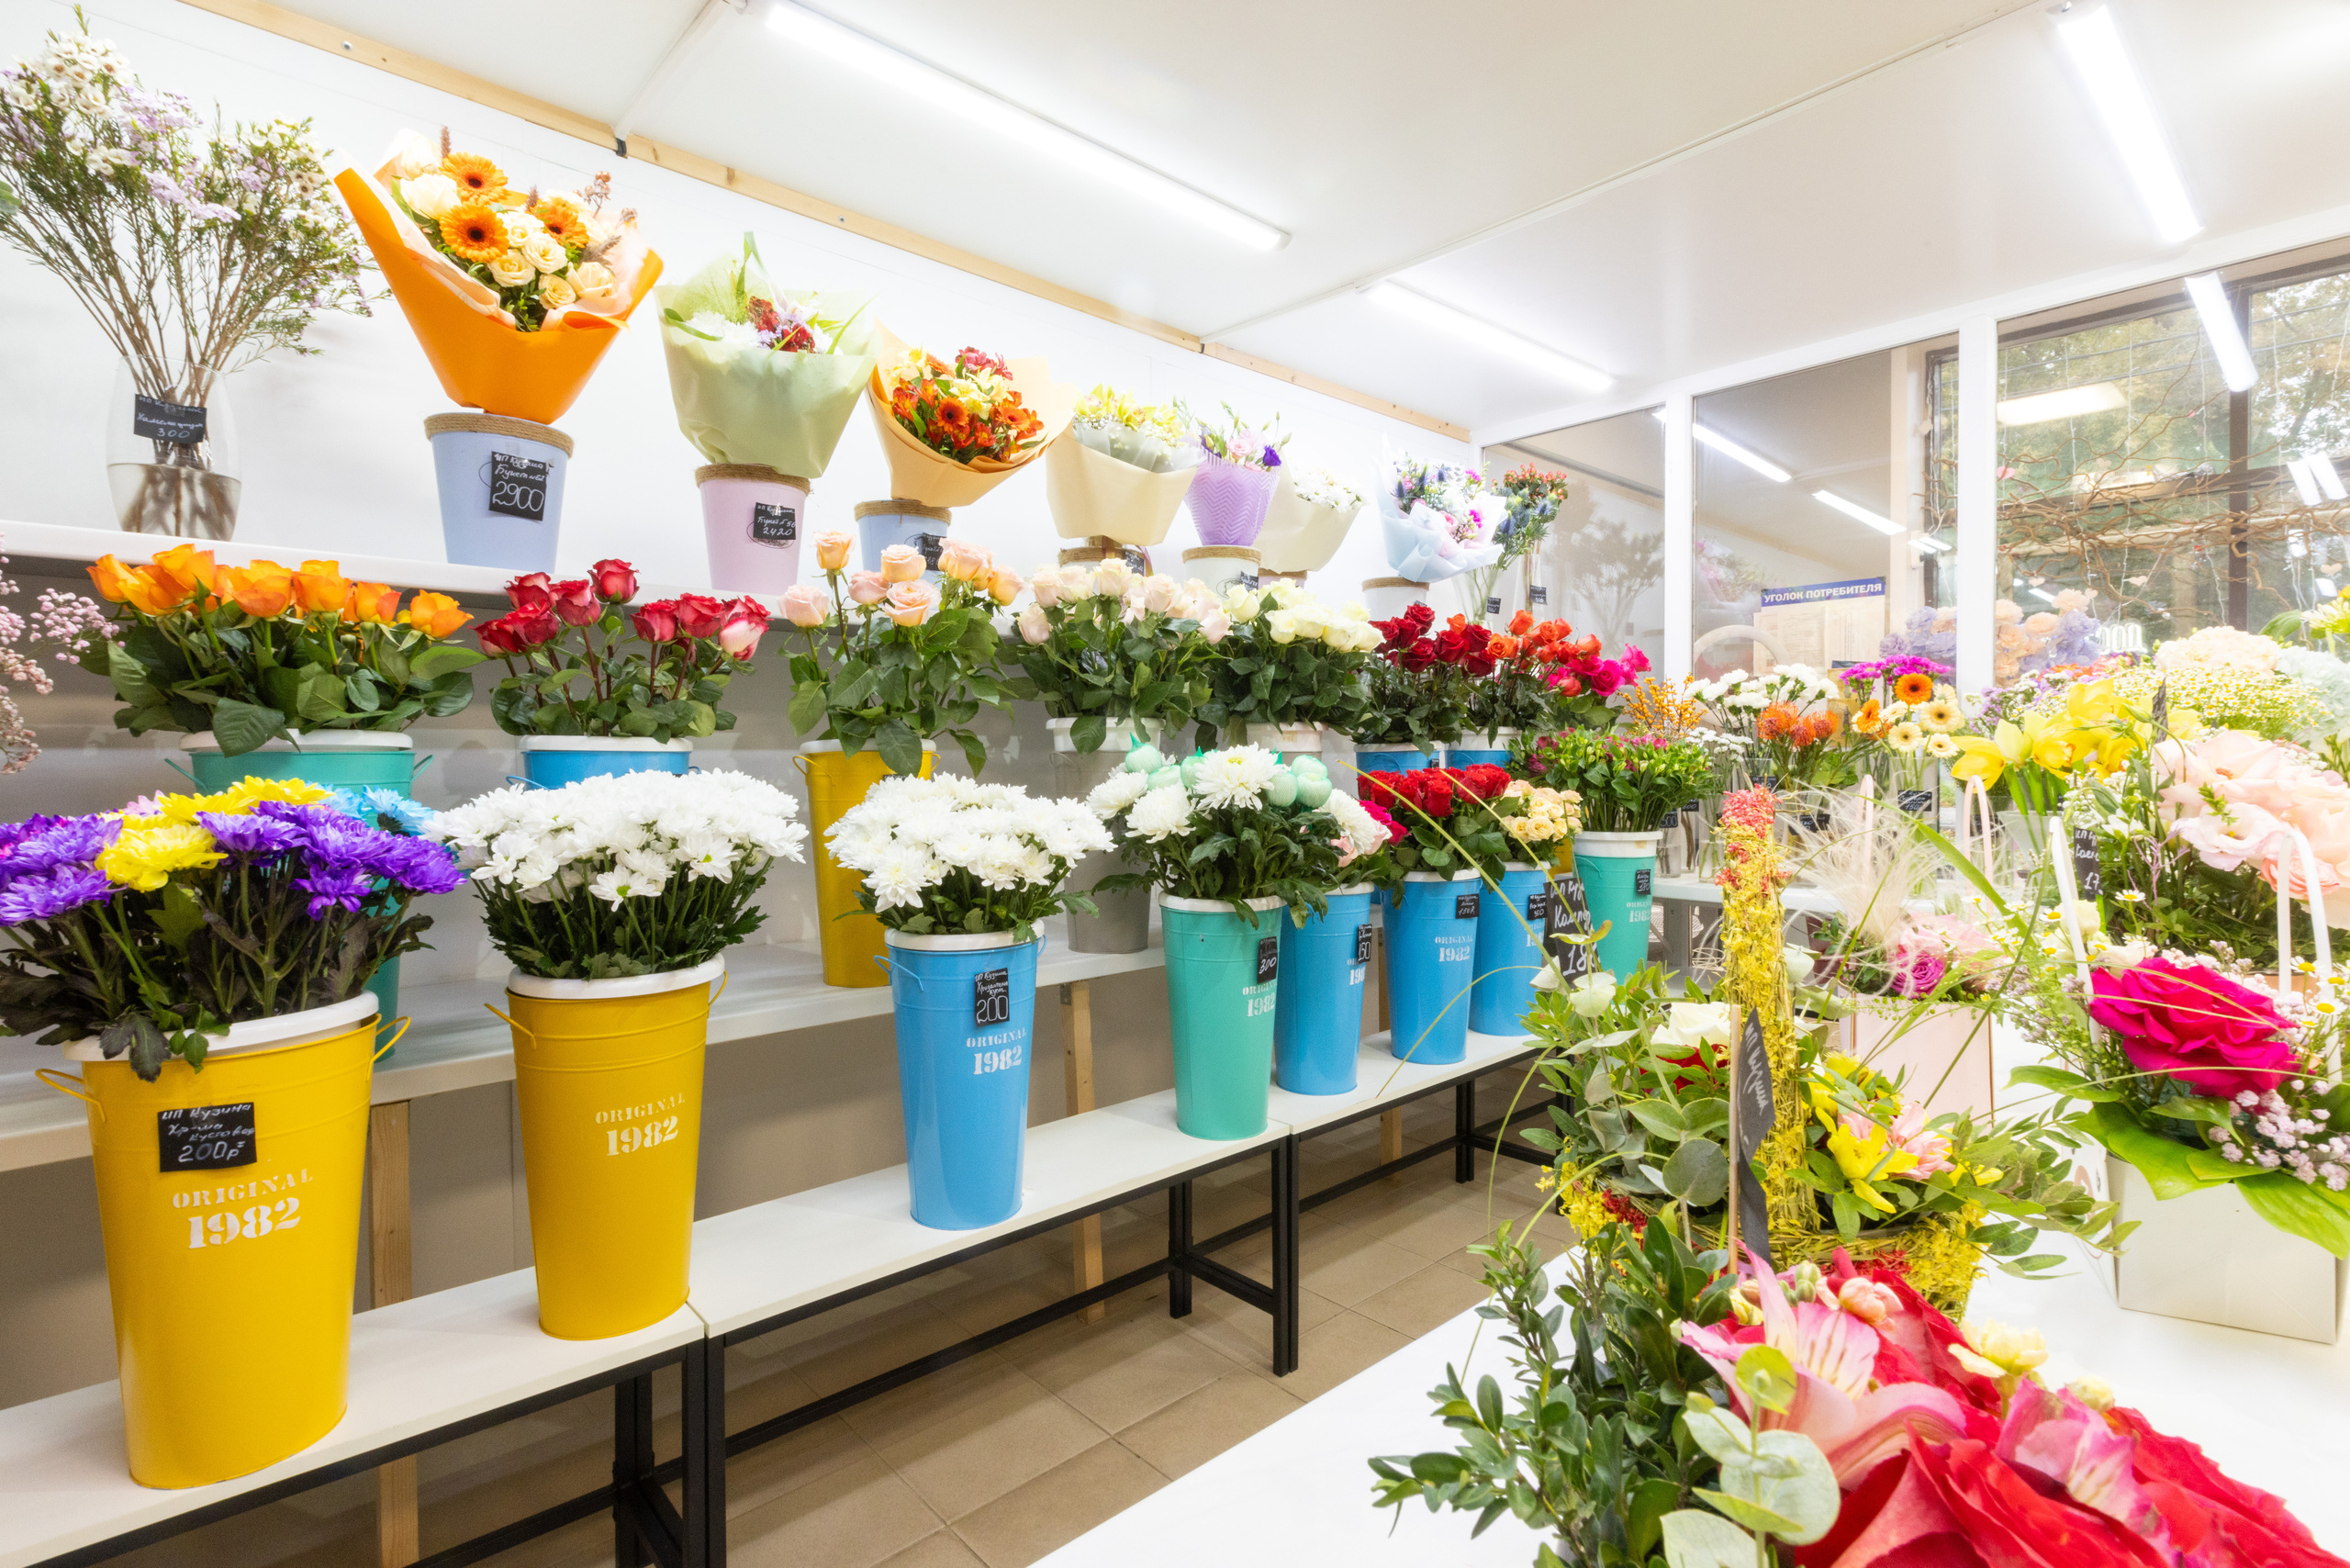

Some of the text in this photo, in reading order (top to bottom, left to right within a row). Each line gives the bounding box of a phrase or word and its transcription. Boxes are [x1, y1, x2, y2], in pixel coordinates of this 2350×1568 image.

[157, 428, 191, 438] 300
[495, 464, 528, 479] Букет
[492, 481, 544, 511] 2900
[763, 527, 793, 536] 2420
[1764, 583, 1882, 603] УГОЛОК ПОТРЕБИТЕЛЯ
[1434, 935, 1473, 945] ORIGINAL
[1438, 946, 1471, 962] 1982
[1259, 957, 1278, 975] 300
[1349, 967, 1366, 985] 198
[976, 995, 1008, 1024] 200
[1247, 991, 1276, 1017] 1982
[966, 1027, 1027, 1047] ORIGINAL
[973, 1045, 1023, 1075] 1982
[162, 1109, 184, 1120] ИП
[594, 1092, 686, 1125] ORIGINAL
[606, 1115, 678, 1157] 1982
[172, 1169, 313, 1208] ORIGINAL
[187, 1197, 301, 1249] 1982
